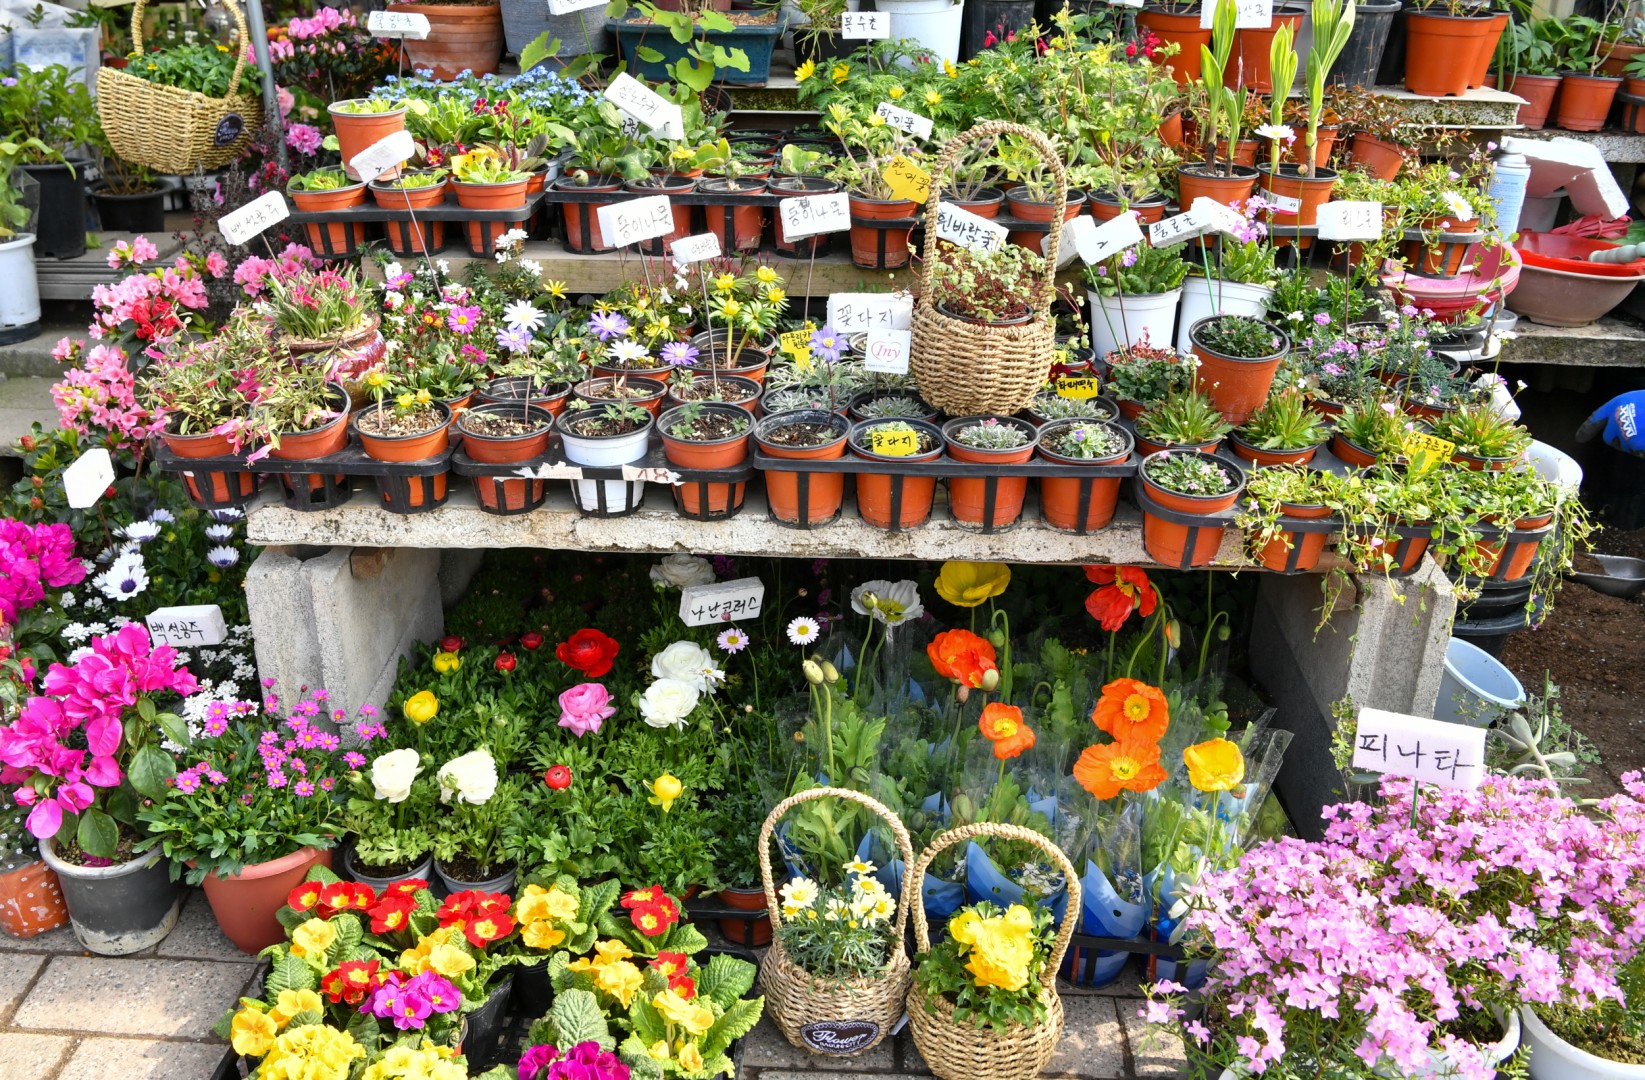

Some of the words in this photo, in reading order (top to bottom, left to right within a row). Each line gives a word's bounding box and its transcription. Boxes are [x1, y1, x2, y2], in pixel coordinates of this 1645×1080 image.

[844, 14, 877, 33] 복수초
[879, 106, 915, 132] 할미꽃
[230, 203, 280, 236] 백설공주
[617, 204, 672, 239] 동이나물
[836, 303, 893, 328] 꽃다지
[876, 344, 901, 360] Iny
[873, 433, 911, 448] 꽃다지
[150, 620, 205, 643] 백설공주
[1359, 733, 1475, 780] 피나타
[812, 1030, 868, 1045] Flower
